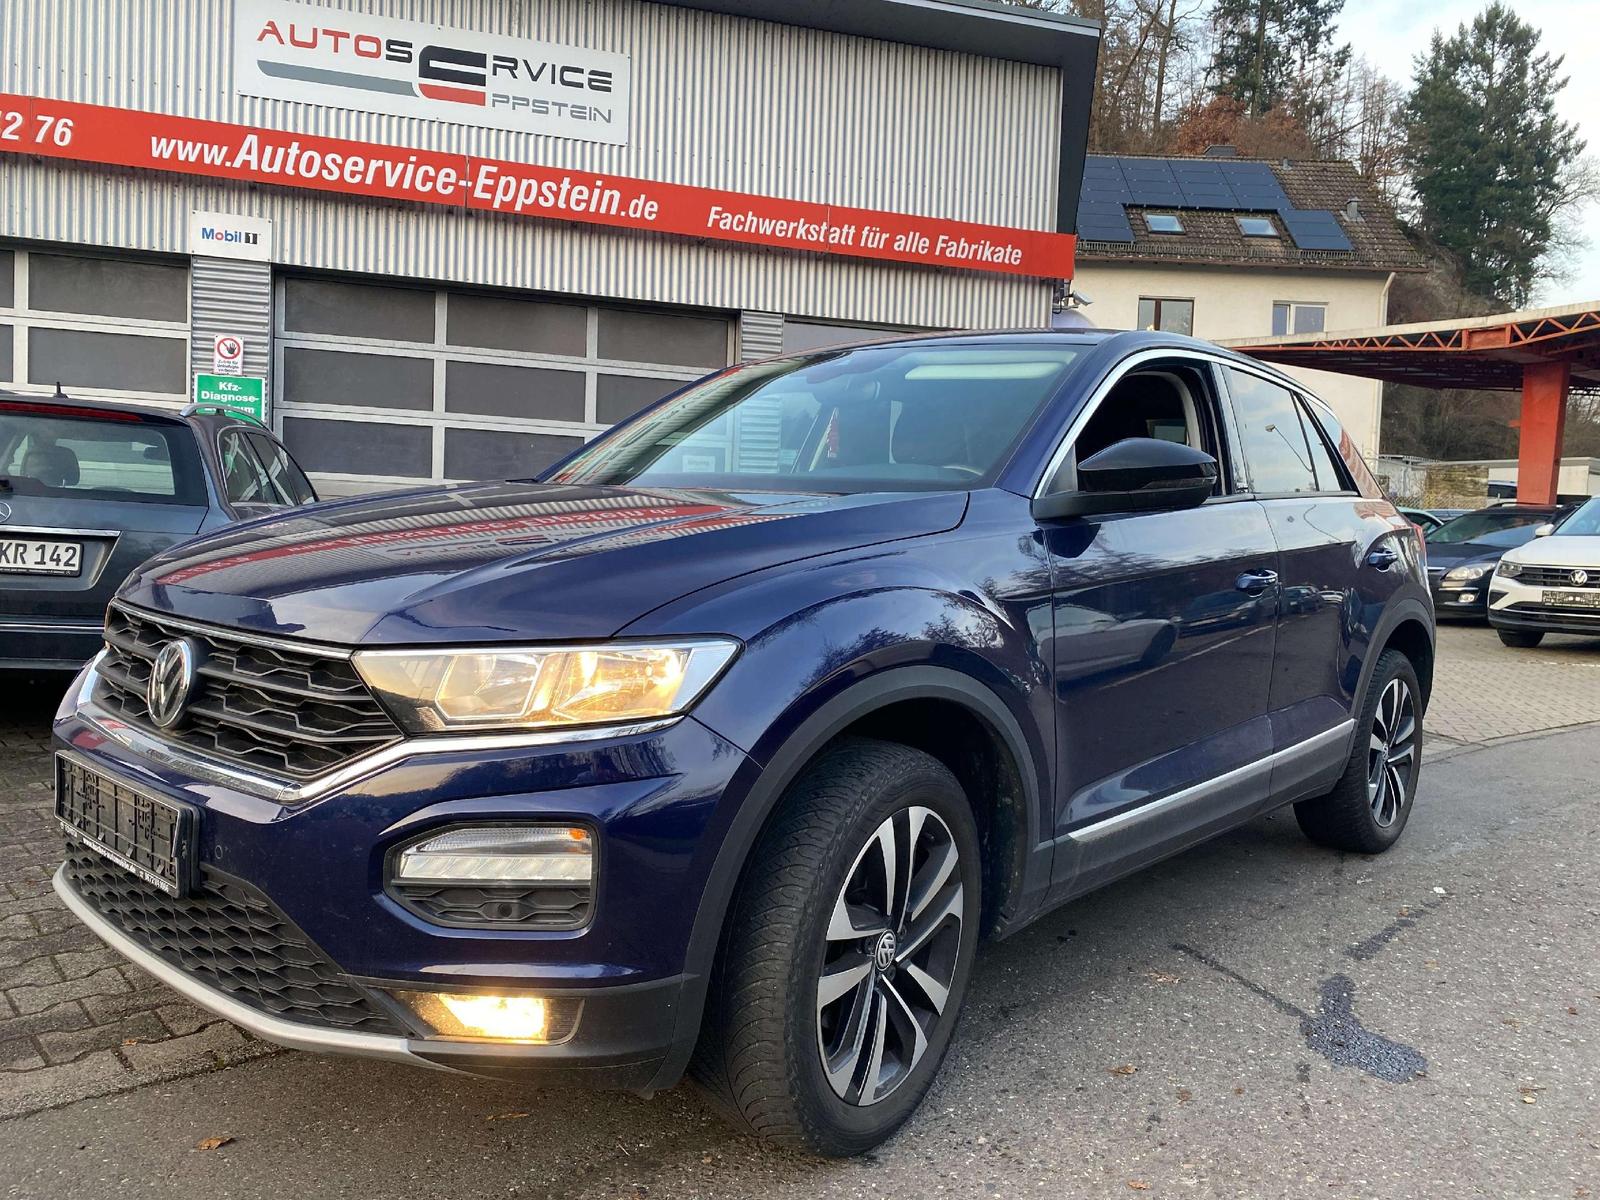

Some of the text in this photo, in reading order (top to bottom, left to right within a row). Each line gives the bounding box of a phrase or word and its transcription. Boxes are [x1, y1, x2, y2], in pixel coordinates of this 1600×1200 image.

[35, 114, 74, 147] 76
[150, 134, 660, 221] www.Autoservice-Eppstein.de
[201, 227, 242, 244] Mobil
[707, 205, 1023, 266] Fachwerkstatt für alle Fabrikate
[201, 391, 259, 402] Diagnose-
[218, 382, 242, 391] Kfz-
[34, 544, 77, 567] 142
